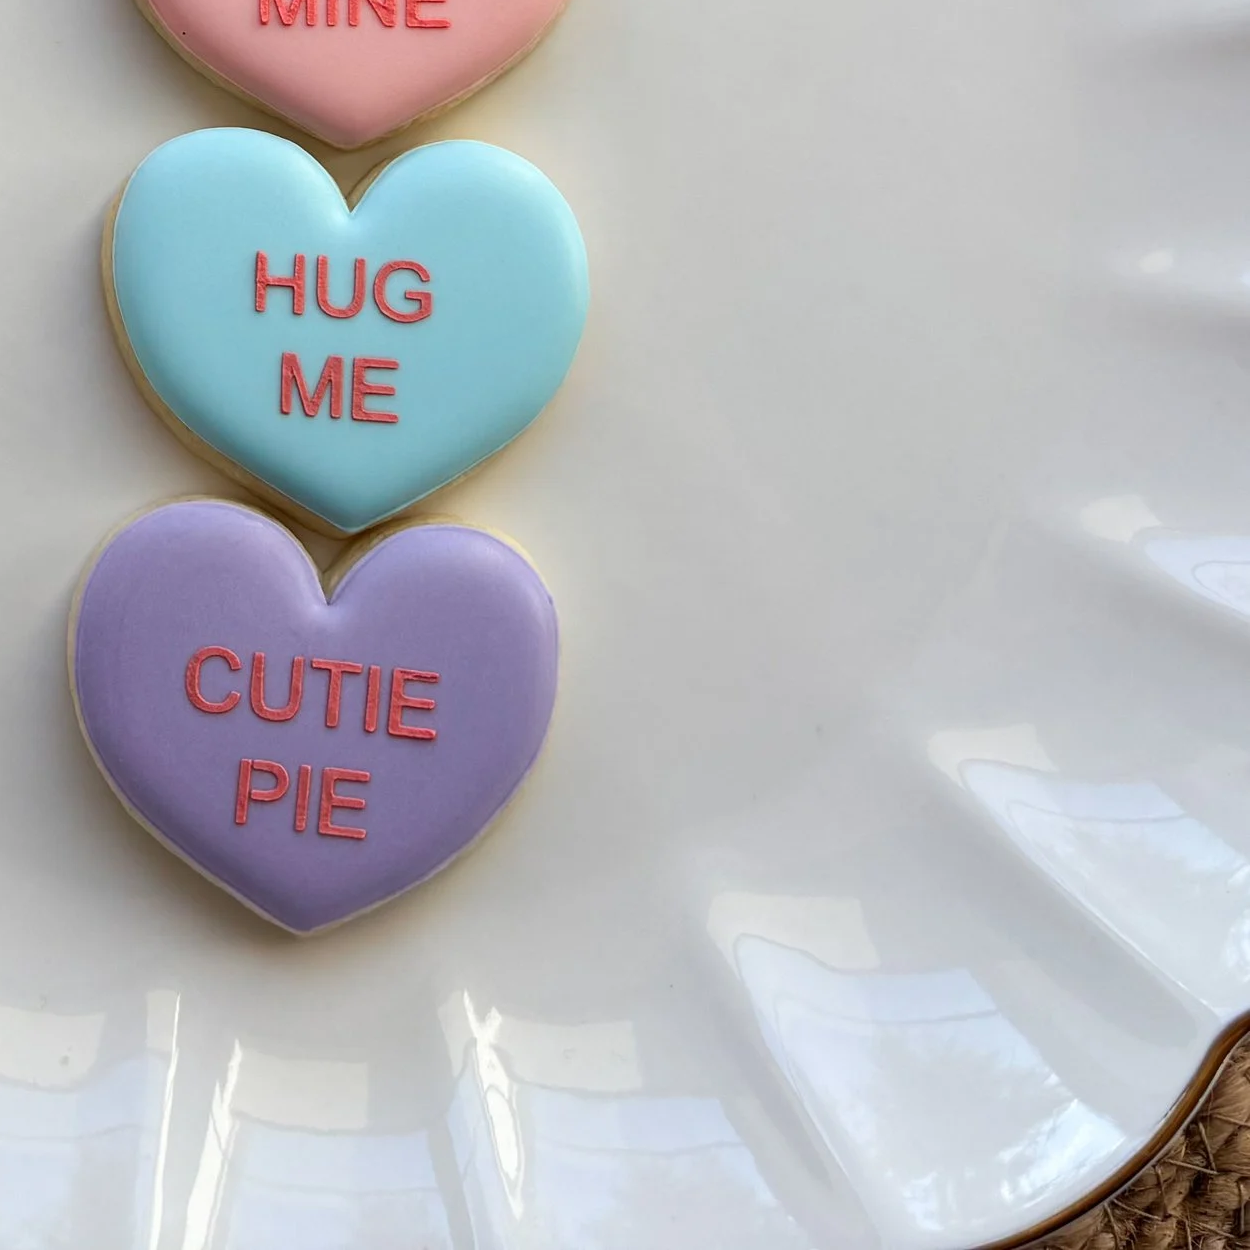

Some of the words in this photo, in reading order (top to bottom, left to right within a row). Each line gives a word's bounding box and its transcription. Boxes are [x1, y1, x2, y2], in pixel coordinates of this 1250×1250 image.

[252, 250, 433, 324] HUG
[277, 351, 400, 424] ME
[183, 645, 440, 741] CUTIE
[232, 758, 371, 841] PIE
